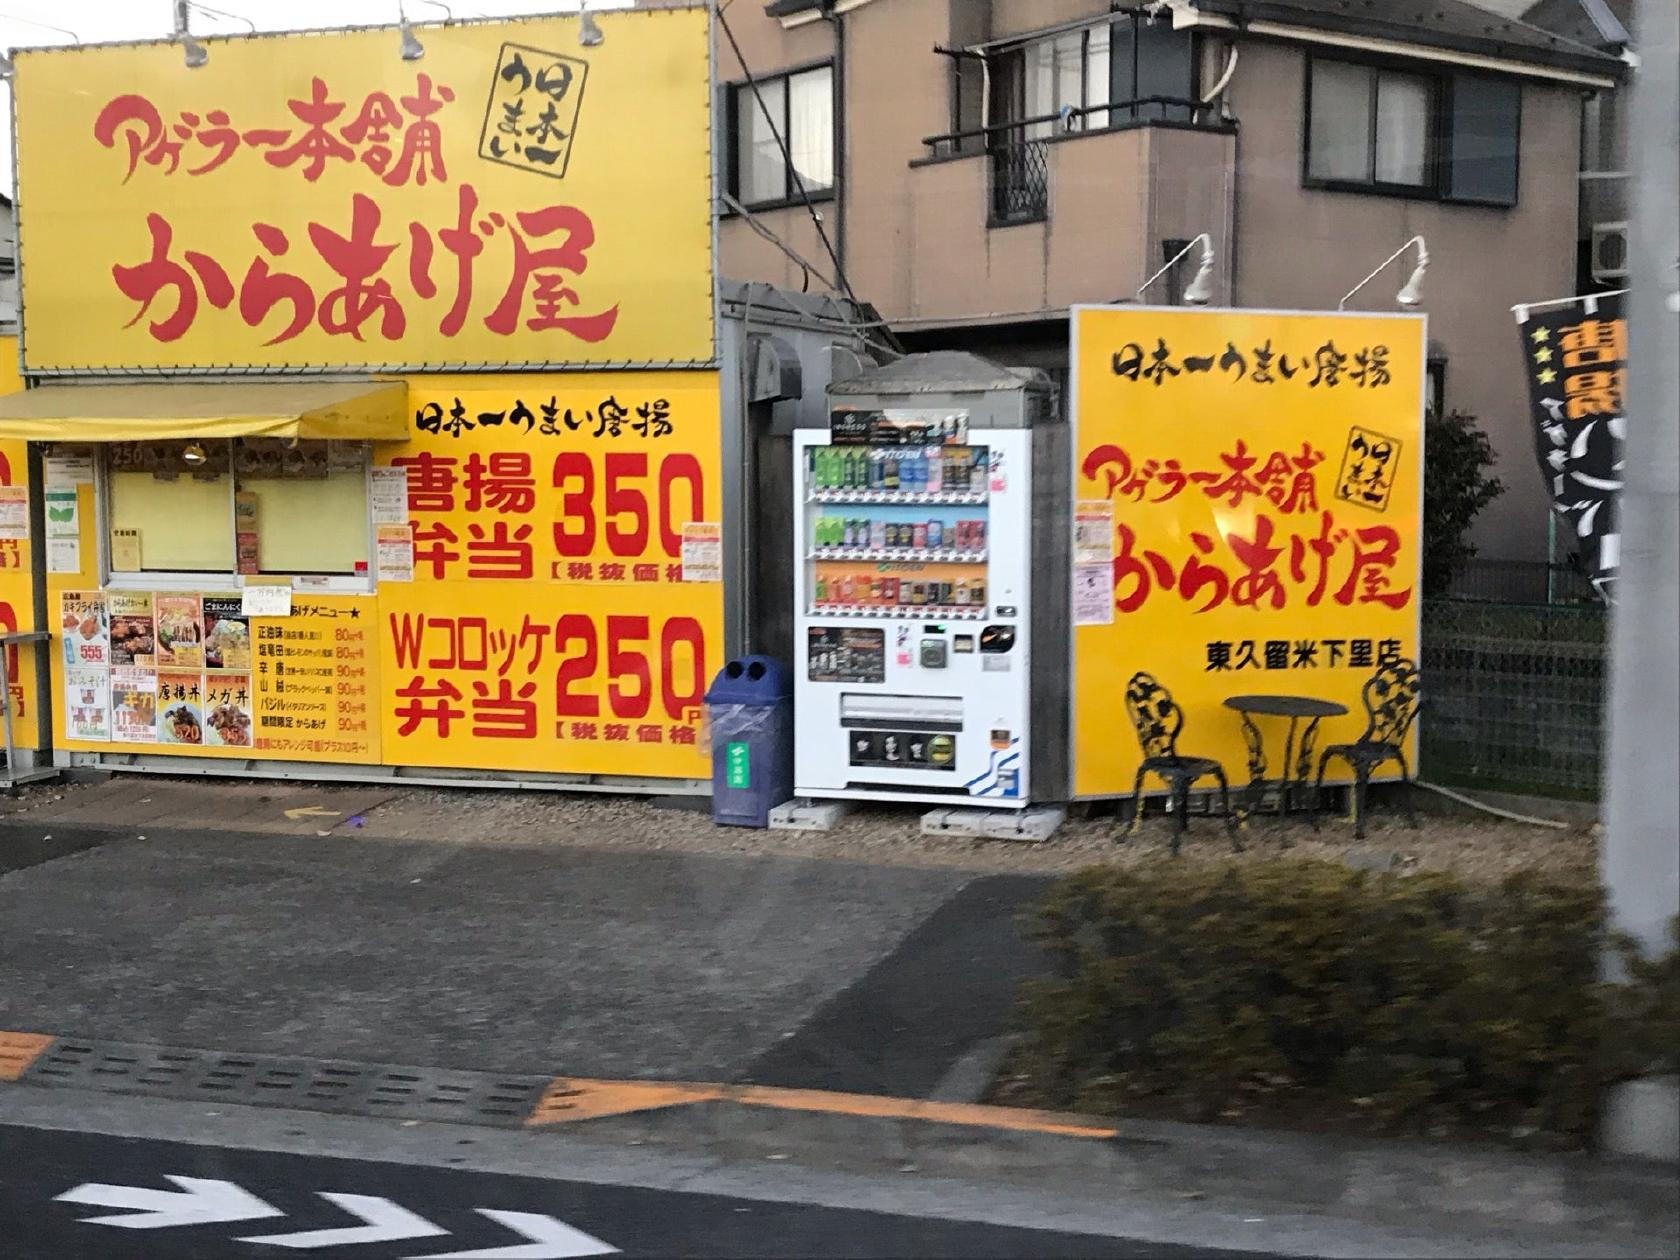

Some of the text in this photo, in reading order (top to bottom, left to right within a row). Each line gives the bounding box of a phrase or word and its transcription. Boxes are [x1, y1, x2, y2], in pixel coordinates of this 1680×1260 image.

[490, 52, 532, 157] うまい
[112, 184, 618, 346] からあげ屋
[1113, 337, 1390, 388] 日本一うまい唐揚
[416, 396, 673, 438] 日本一うまい唐揚
[391, 452, 536, 514] 唐揚
[551, 451, 704, 559] 350
[408, 519, 534, 581] 弁当
[1112, 510, 1411, 615] からあげ屋
[80, 645, 102, 659] 555
[390, 613, 552, 677] Wコロッケ
[1204, 638, 1404, 672] 東久留米下里店
[158, 683, 199, 702] 唐揚丼
[207, 687, 248, 708] メガ丼
[394, 675, 538, 739] 弁当
